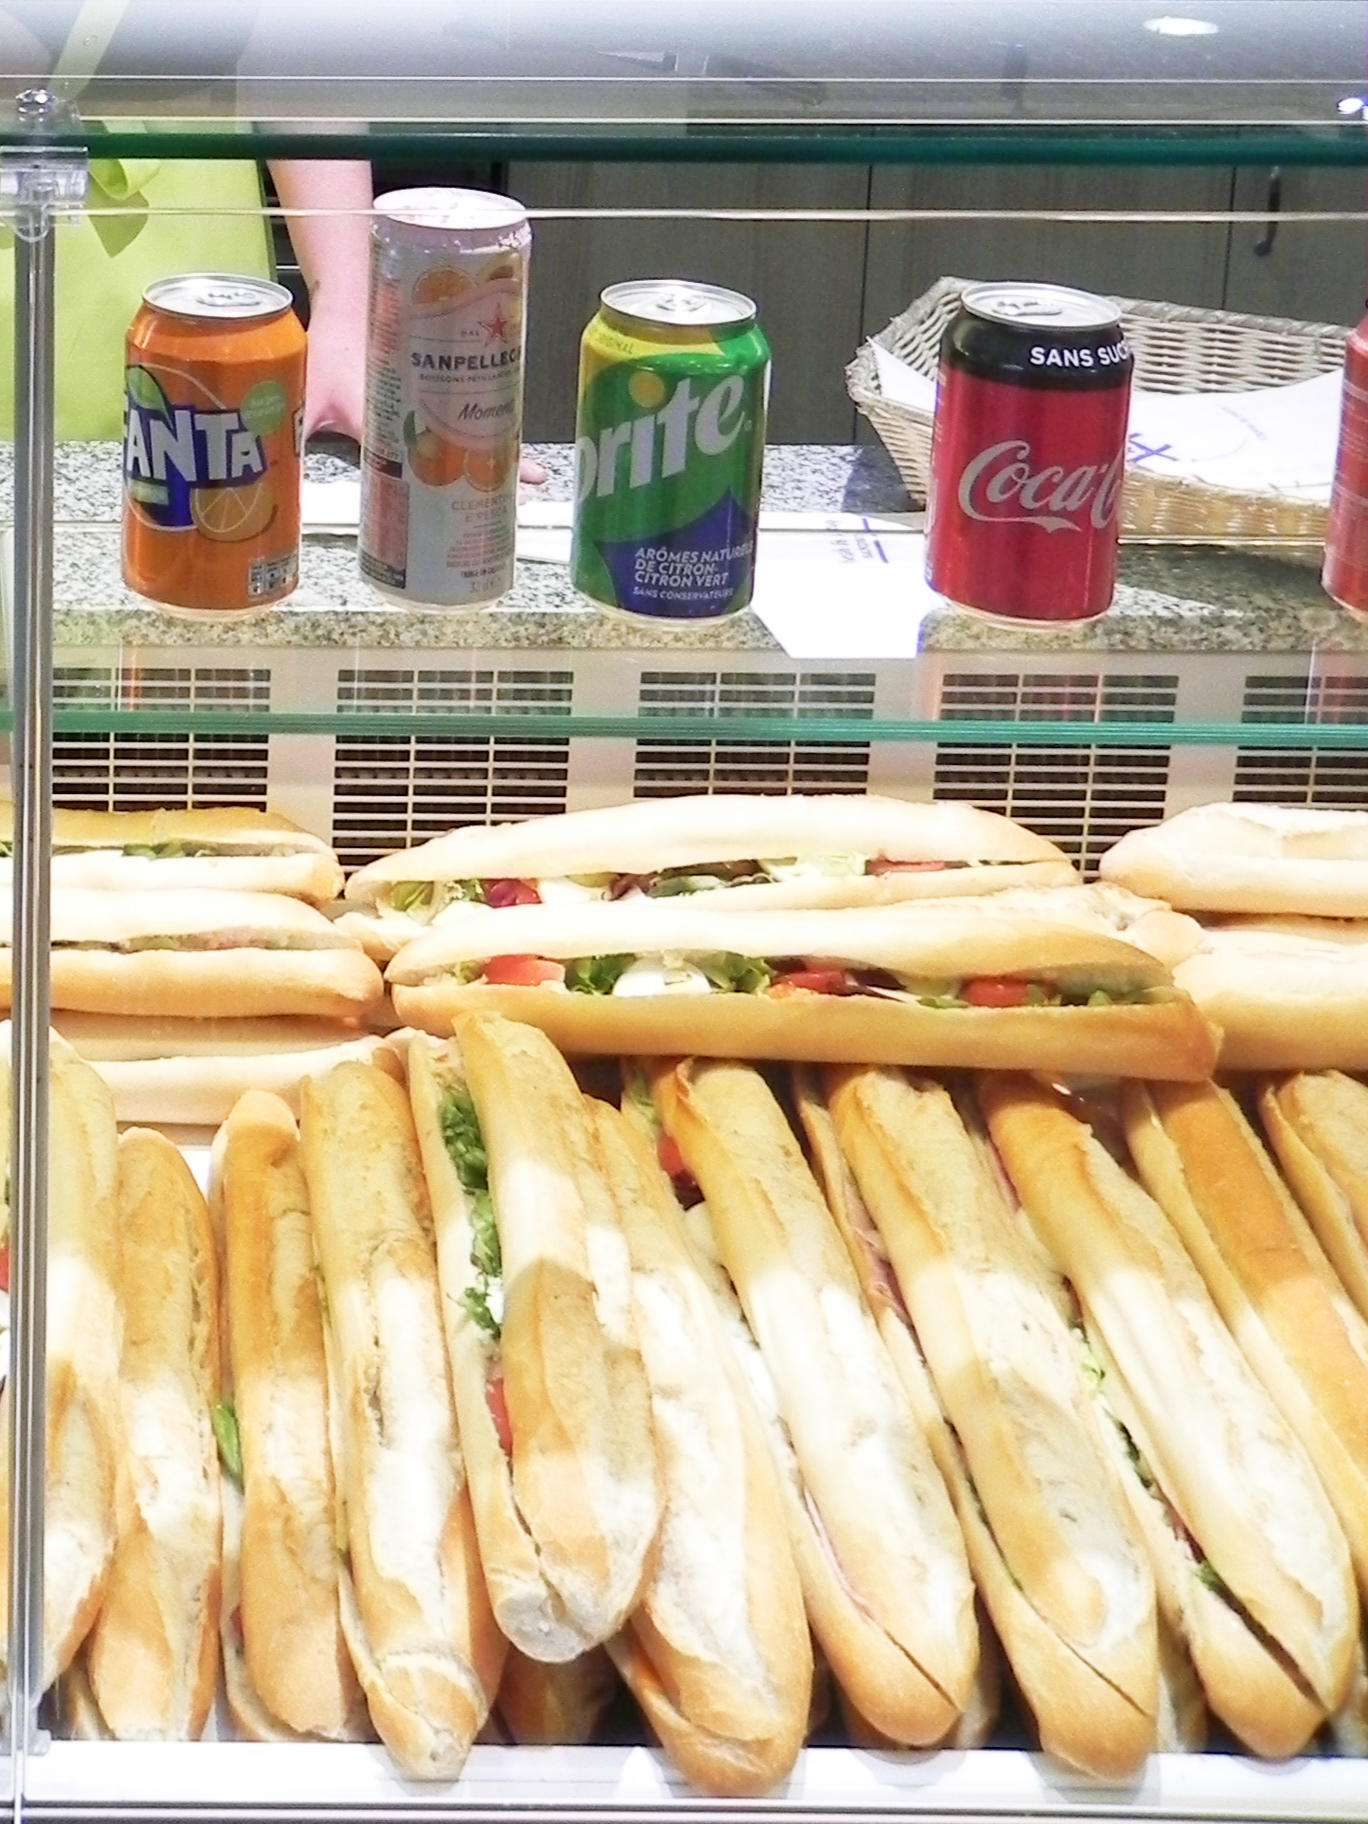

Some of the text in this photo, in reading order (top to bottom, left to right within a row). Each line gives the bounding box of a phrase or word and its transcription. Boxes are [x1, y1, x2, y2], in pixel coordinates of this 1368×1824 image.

[1030, 346, 1094, 367] SANS
[124, 407, 265, 482] ANTA
[634, 546, 700, 563] ARÔMES
[634, 559, 657, 573] DE
[634, 571, 730, 587] CITRON VERT
[633, 586, 658, 598] SANS
